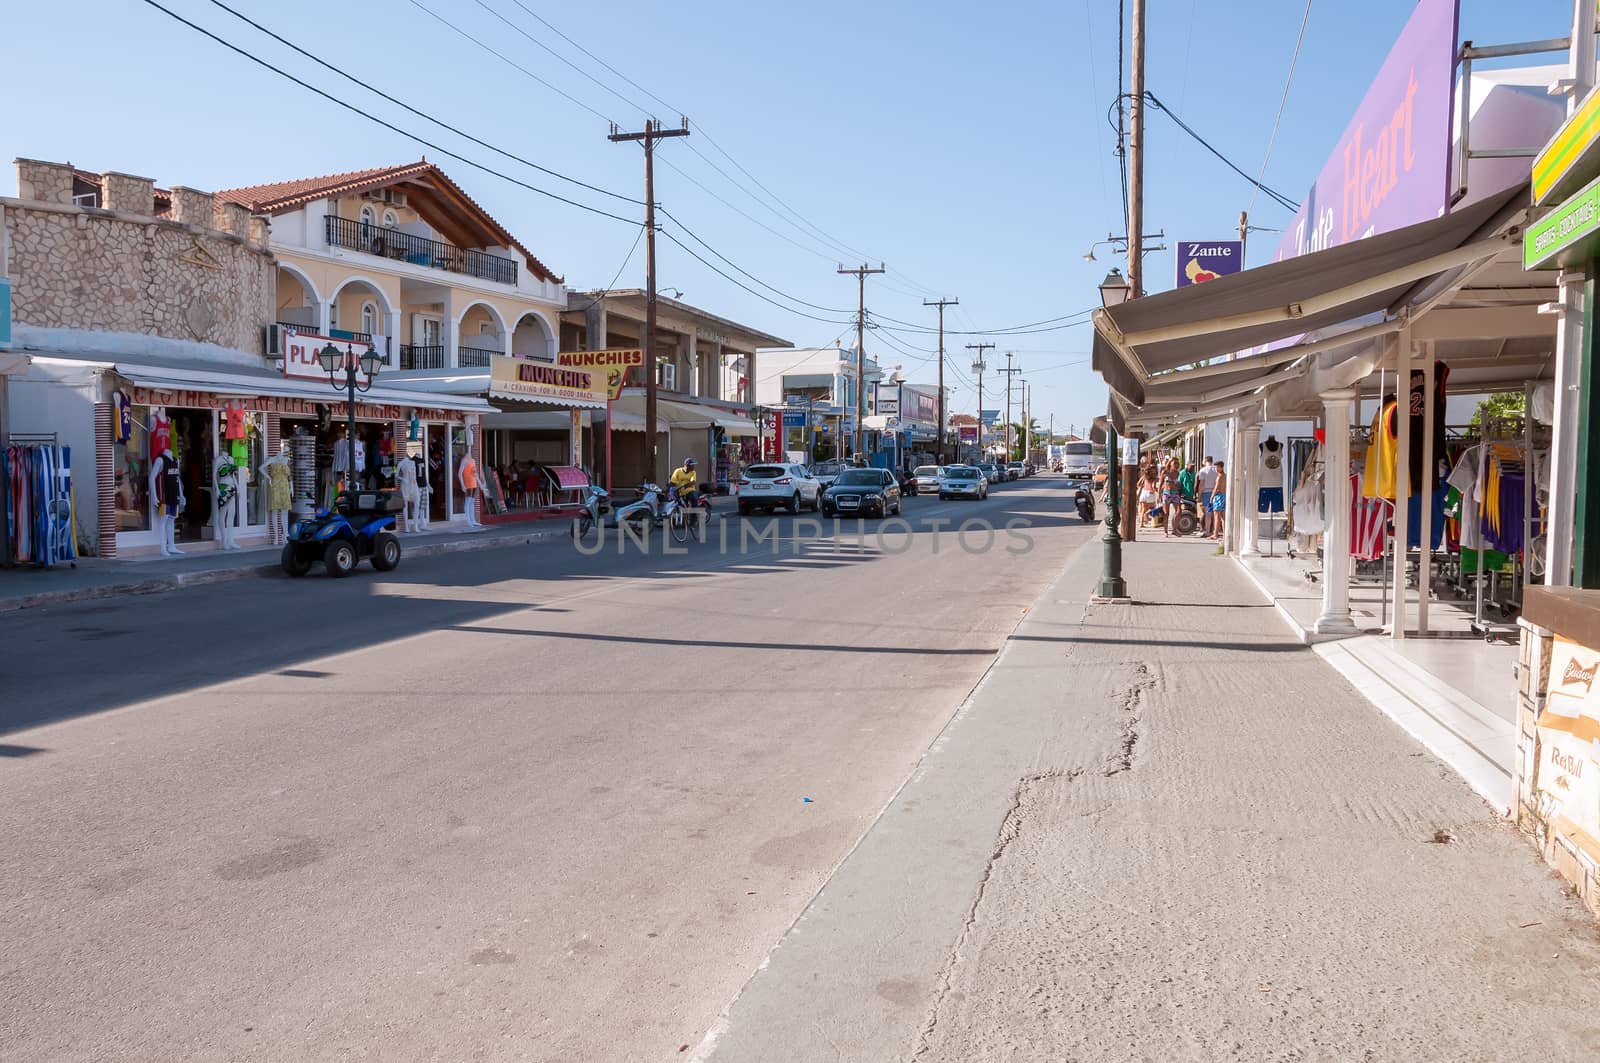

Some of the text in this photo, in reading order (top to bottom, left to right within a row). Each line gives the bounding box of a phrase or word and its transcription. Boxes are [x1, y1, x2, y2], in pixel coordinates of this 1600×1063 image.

[1341, 64, 1418, 246] Heart
[1560, 199, 1593, 238] COCKTAILS
[1188, 243, 1232, 257] Zante
[559, 351, 641, 366] MUNCHIES
[520, 364, 592, 389] MUNCHIES
[134, 386, 222, 409] CLOTHES
